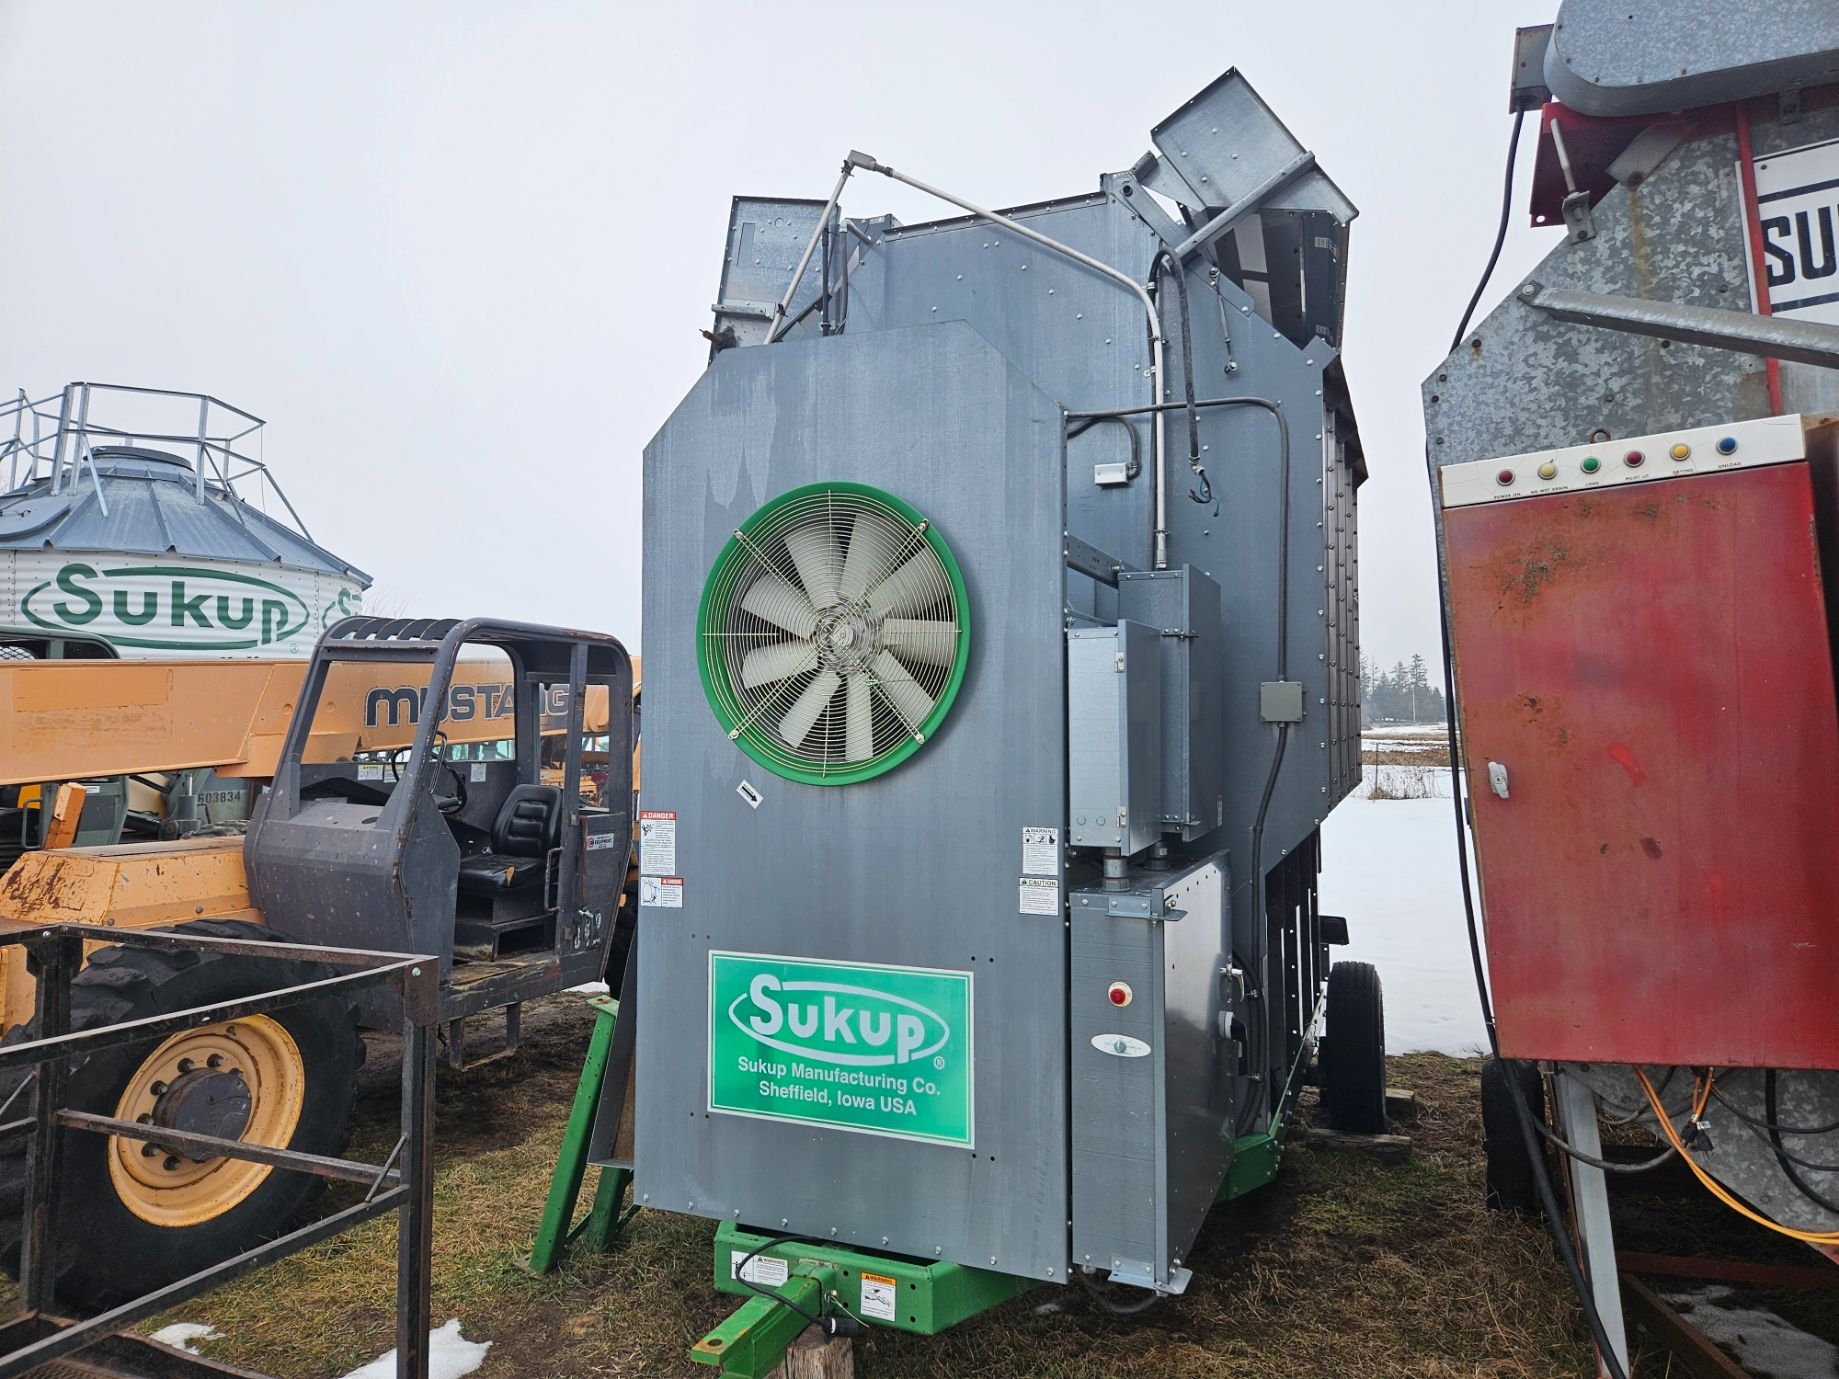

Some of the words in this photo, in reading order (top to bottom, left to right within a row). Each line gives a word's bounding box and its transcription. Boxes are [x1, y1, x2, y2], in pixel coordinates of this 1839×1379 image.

[1761, 203, 1839, 287] SU
[53, 563, 289, 647] Sukup
[365, 683, 569, 728] MSTAG
[1028, 879, 1056, 887] CAUTION
[749, 973, 925, 1064] Sukup
[738, 1056, 787, 1077] Sukup
[791, 1063, 908, 1093] Manufacturing
[912, 1077, 941, 1095] Co.
[759, 1080, 832, 1107] Sheffield,
[837, 1091, 875, 1110] Iowa
[880, 1096, 917, 1116] USA
